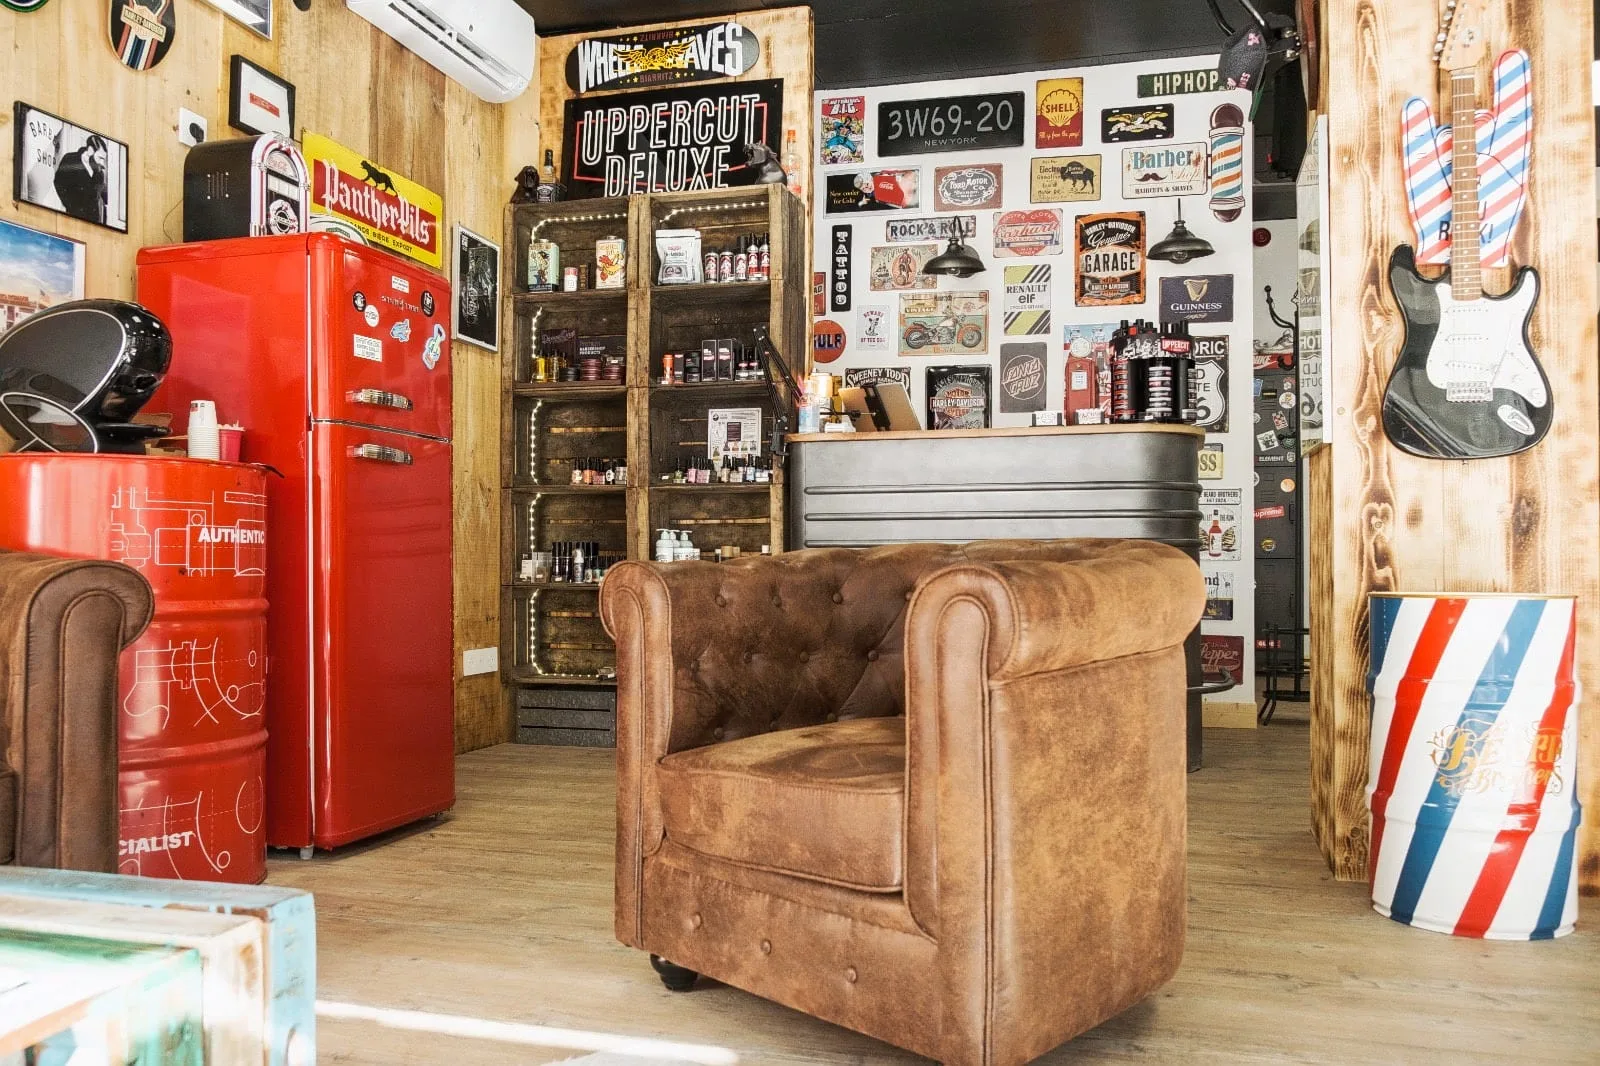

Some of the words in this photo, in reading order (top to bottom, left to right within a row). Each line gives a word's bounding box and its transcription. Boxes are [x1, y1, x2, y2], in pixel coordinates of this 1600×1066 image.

[639, 71, 674, 83] BIARRITZ
[1046, 103, 1074, 113] SHELL
[888, 100, 1014, 140] 3W69-20
[582, 94, 760, 166] UPPERCUT
[924, 139, 947, 147] NEW
[37, 148, 57, 168] SHOP
[1133, 150, 1193, 169] Barber
[604, 145, 731, 198] DELUXE
[1084, 221, 1136, 236] HARLEY-DAVIDSON
[393, 239, 413, 254] EXPORT
[835, 231, 848, 305] TATTOO
[1085, 252, 1136, 273] GARAGE
[1006, 285, 1047, 294] RENAULT
[1018, 293, 1036, 304] elf
[1170, 302, 1222, 311] GUINNESS
[1162, 339, 1190, 350] UPPERCUT
[1007, 358, 1040, 381] SANTA
[847, 369, 881, 388] SWEENEY
[885, 368, 909, 390] TODD
[1009, 373, 1040, 396] CRUZ
[932, 398, 984, 407] HARLEY-DAVIDSON
[199, 527, 264, 544] AUTHENTIC
